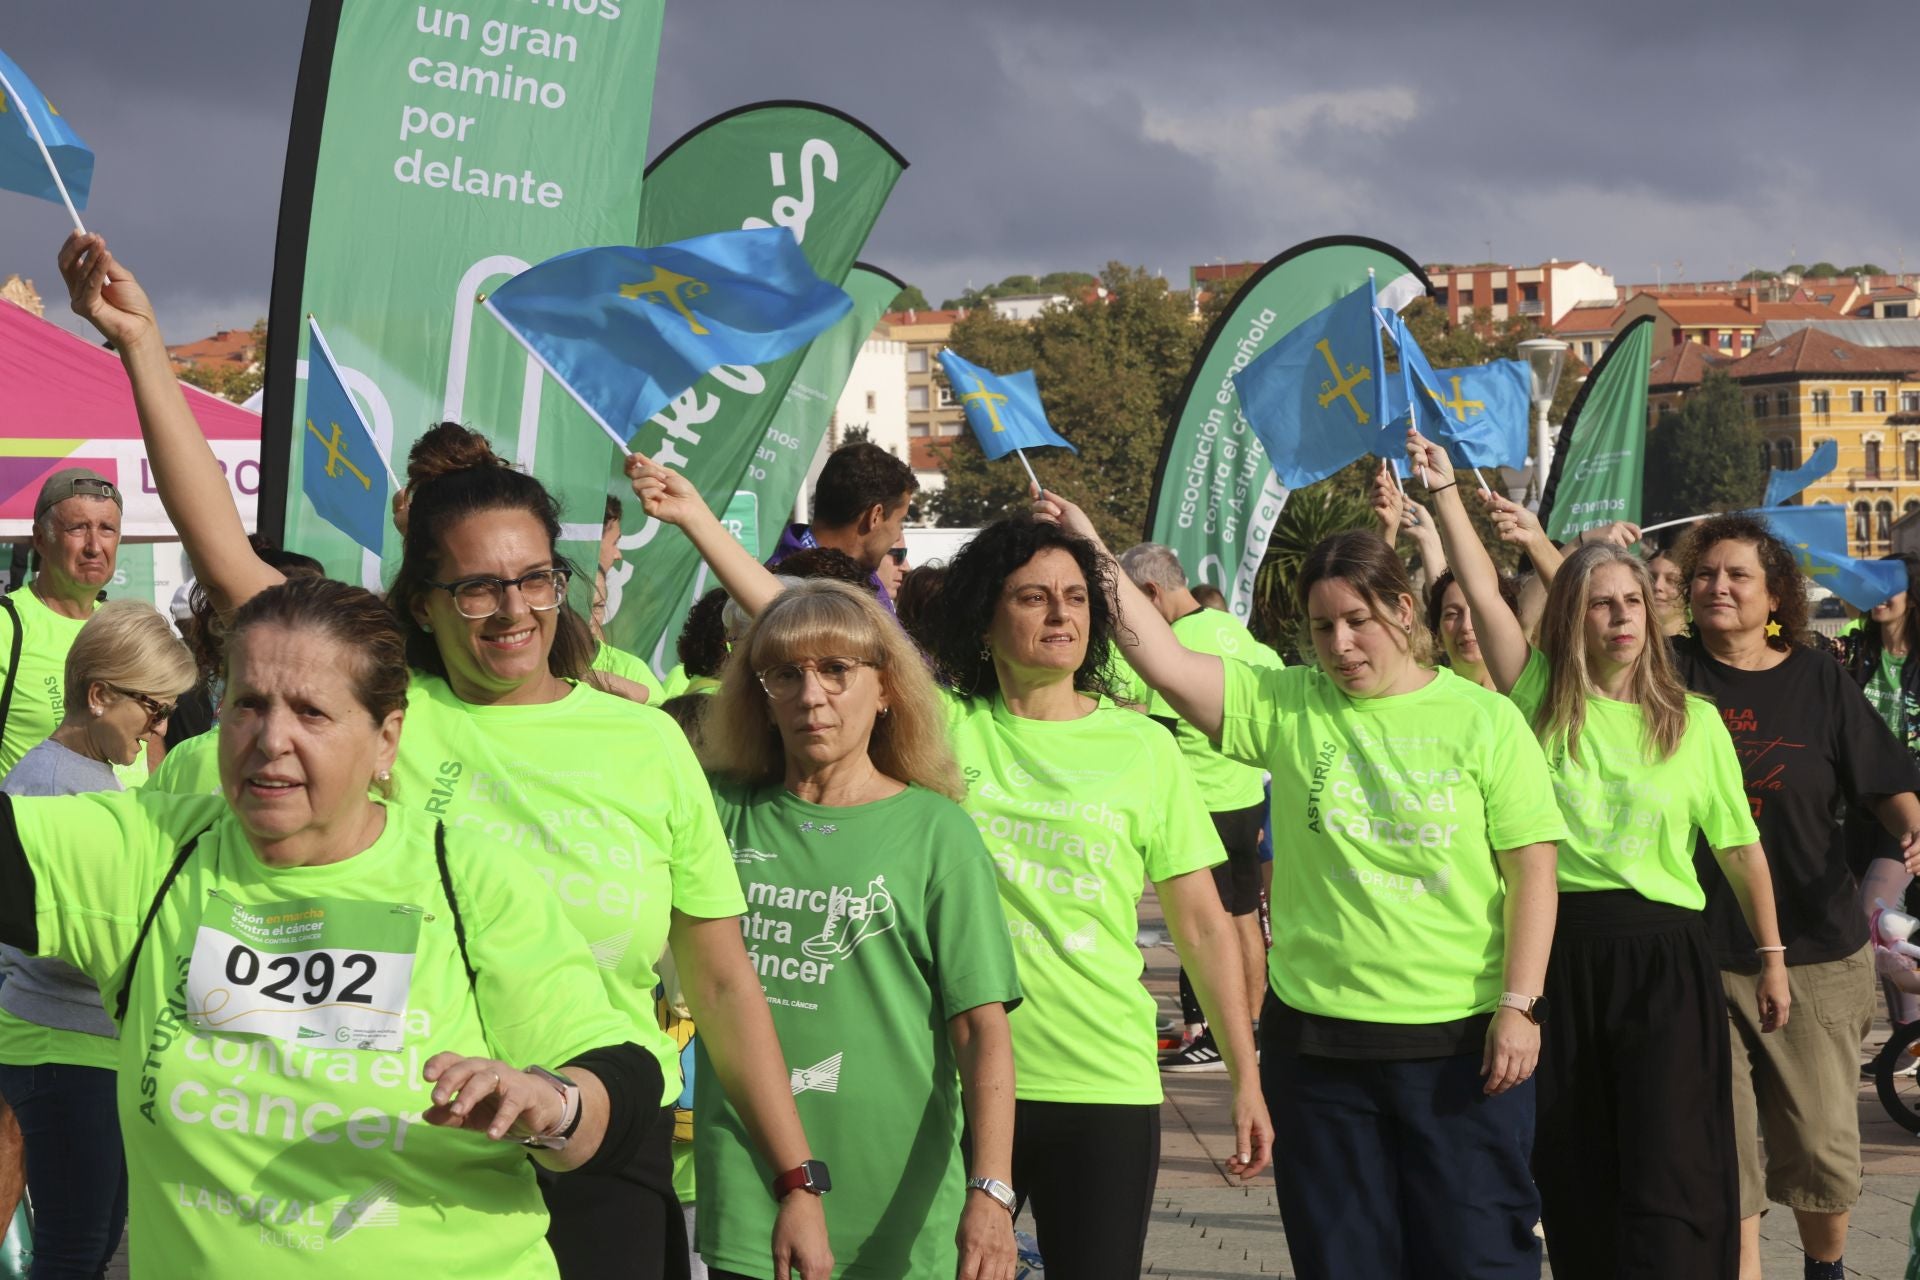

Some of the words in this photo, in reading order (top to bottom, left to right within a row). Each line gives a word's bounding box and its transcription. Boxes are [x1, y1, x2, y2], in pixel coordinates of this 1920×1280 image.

[416, 6, 470, 40] un
[480, 19, 578, 62] gran
[408, 56, 567, 109] camino
[399, 105, 475, 142] por
[393, 149, 564, 208] delante
[1178, 408, 1225, 529] asociación
[1216, 308, 1277, 405] española
[1203, 462, 1232, 535] contra
[1223, 436, 1240, 460] el
[1571, 499, 1625, 514] enemos
[1222, 515, 1240, 544] en
[44, 676, 66, 729] TURIAS
[1729, 720, 1758, 732] ON
[424, 760, 463, 815] RIAS
[466, 771, 511, 804] En
[1307, 740, 1337, 834] ASTURIAS
[1427, 786, 1457, 813] el
[1325, 807, 1461, 849] cáncer
[607, 839, 645, 874] el
[1089, 838, 1118, 869] el
[266, 914, 280, 925] en
[283, 903, 325, 923] marcha
[747, 881, 868, 921] marcha
[272, 925, 283, 936] el
[286, 921, 325, 935] cáncer
[740, 911, 793, 944] ntra
[225, 944, 377, 1005] 0292
[748, 944, 835, 985] áncer
[184, 1034, 358, 1084] contra
[370, 1046, 422, 1091] el
[169, 1074, 423, 1151] cáncer
[177, 1182, 325, 1228] LABORAL
[259, 1226, 325, 1251] kutxa
